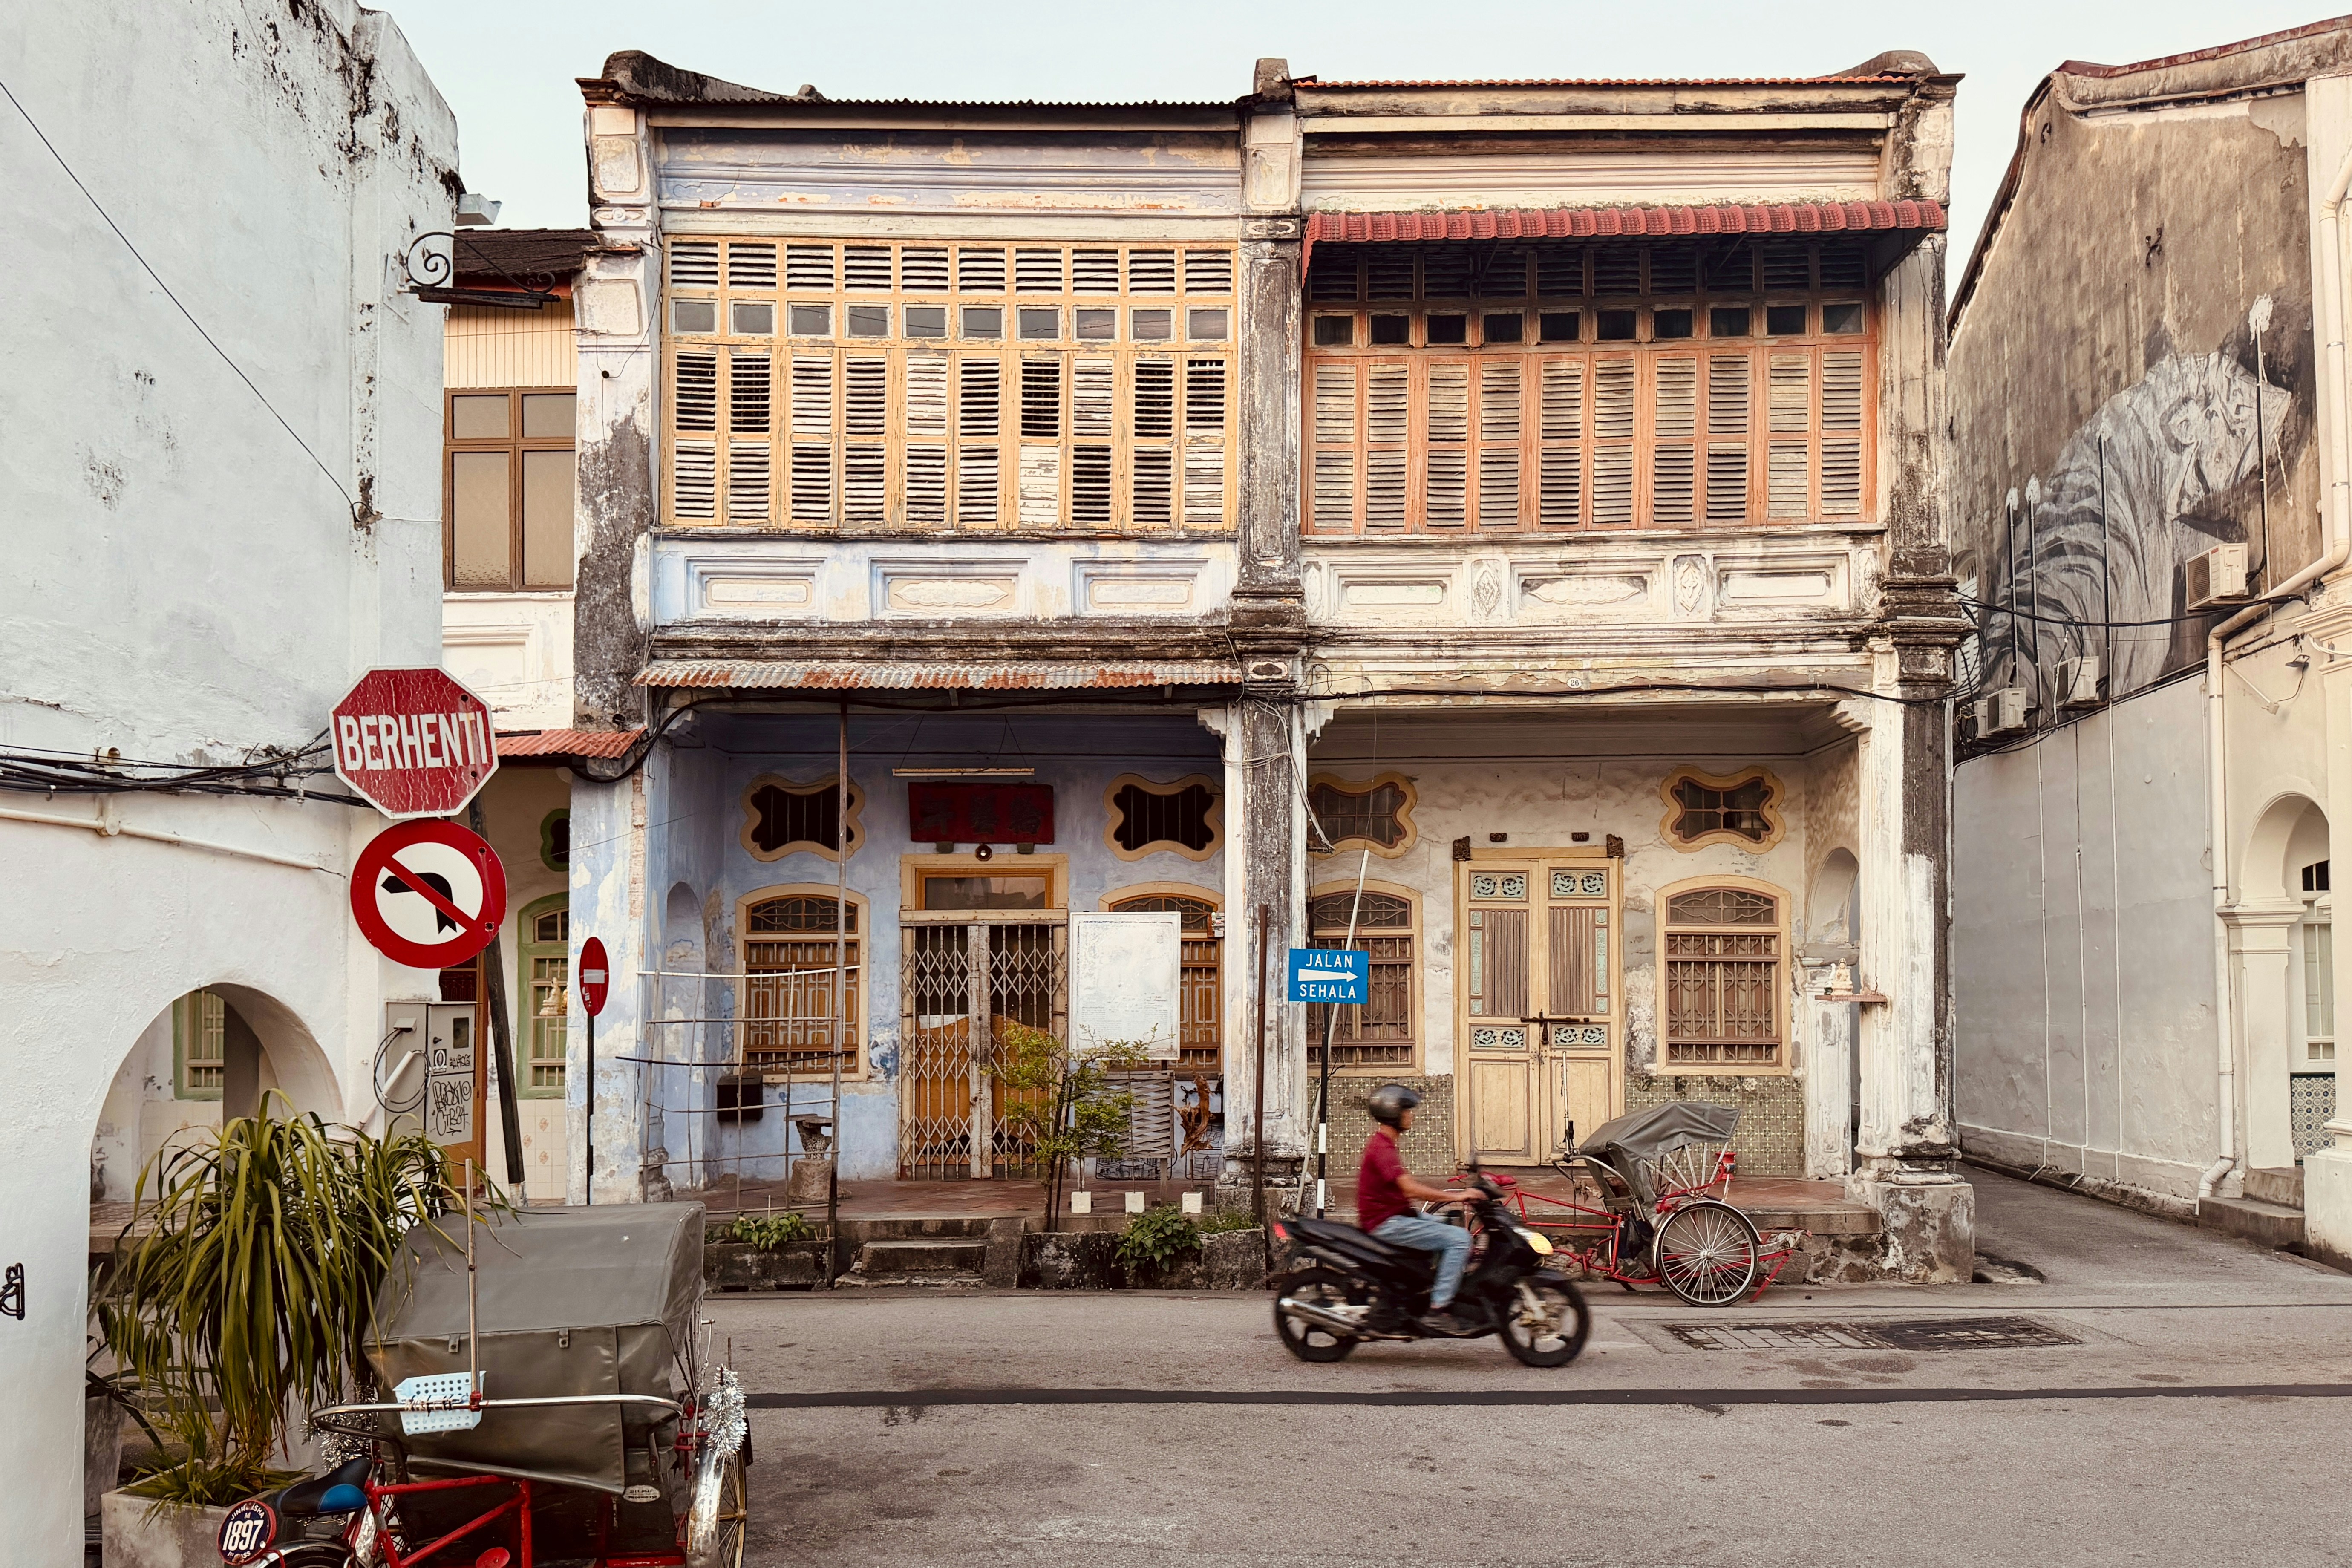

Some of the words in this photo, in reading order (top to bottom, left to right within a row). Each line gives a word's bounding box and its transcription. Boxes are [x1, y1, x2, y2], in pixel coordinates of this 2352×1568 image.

[338, 711, 489, 770] BERHENTI
[1306, 954, 1352, 968] JALAN
[1300, 984, 1356, 998] SEHALA
[222, 1519, 264, 1551] 1897
